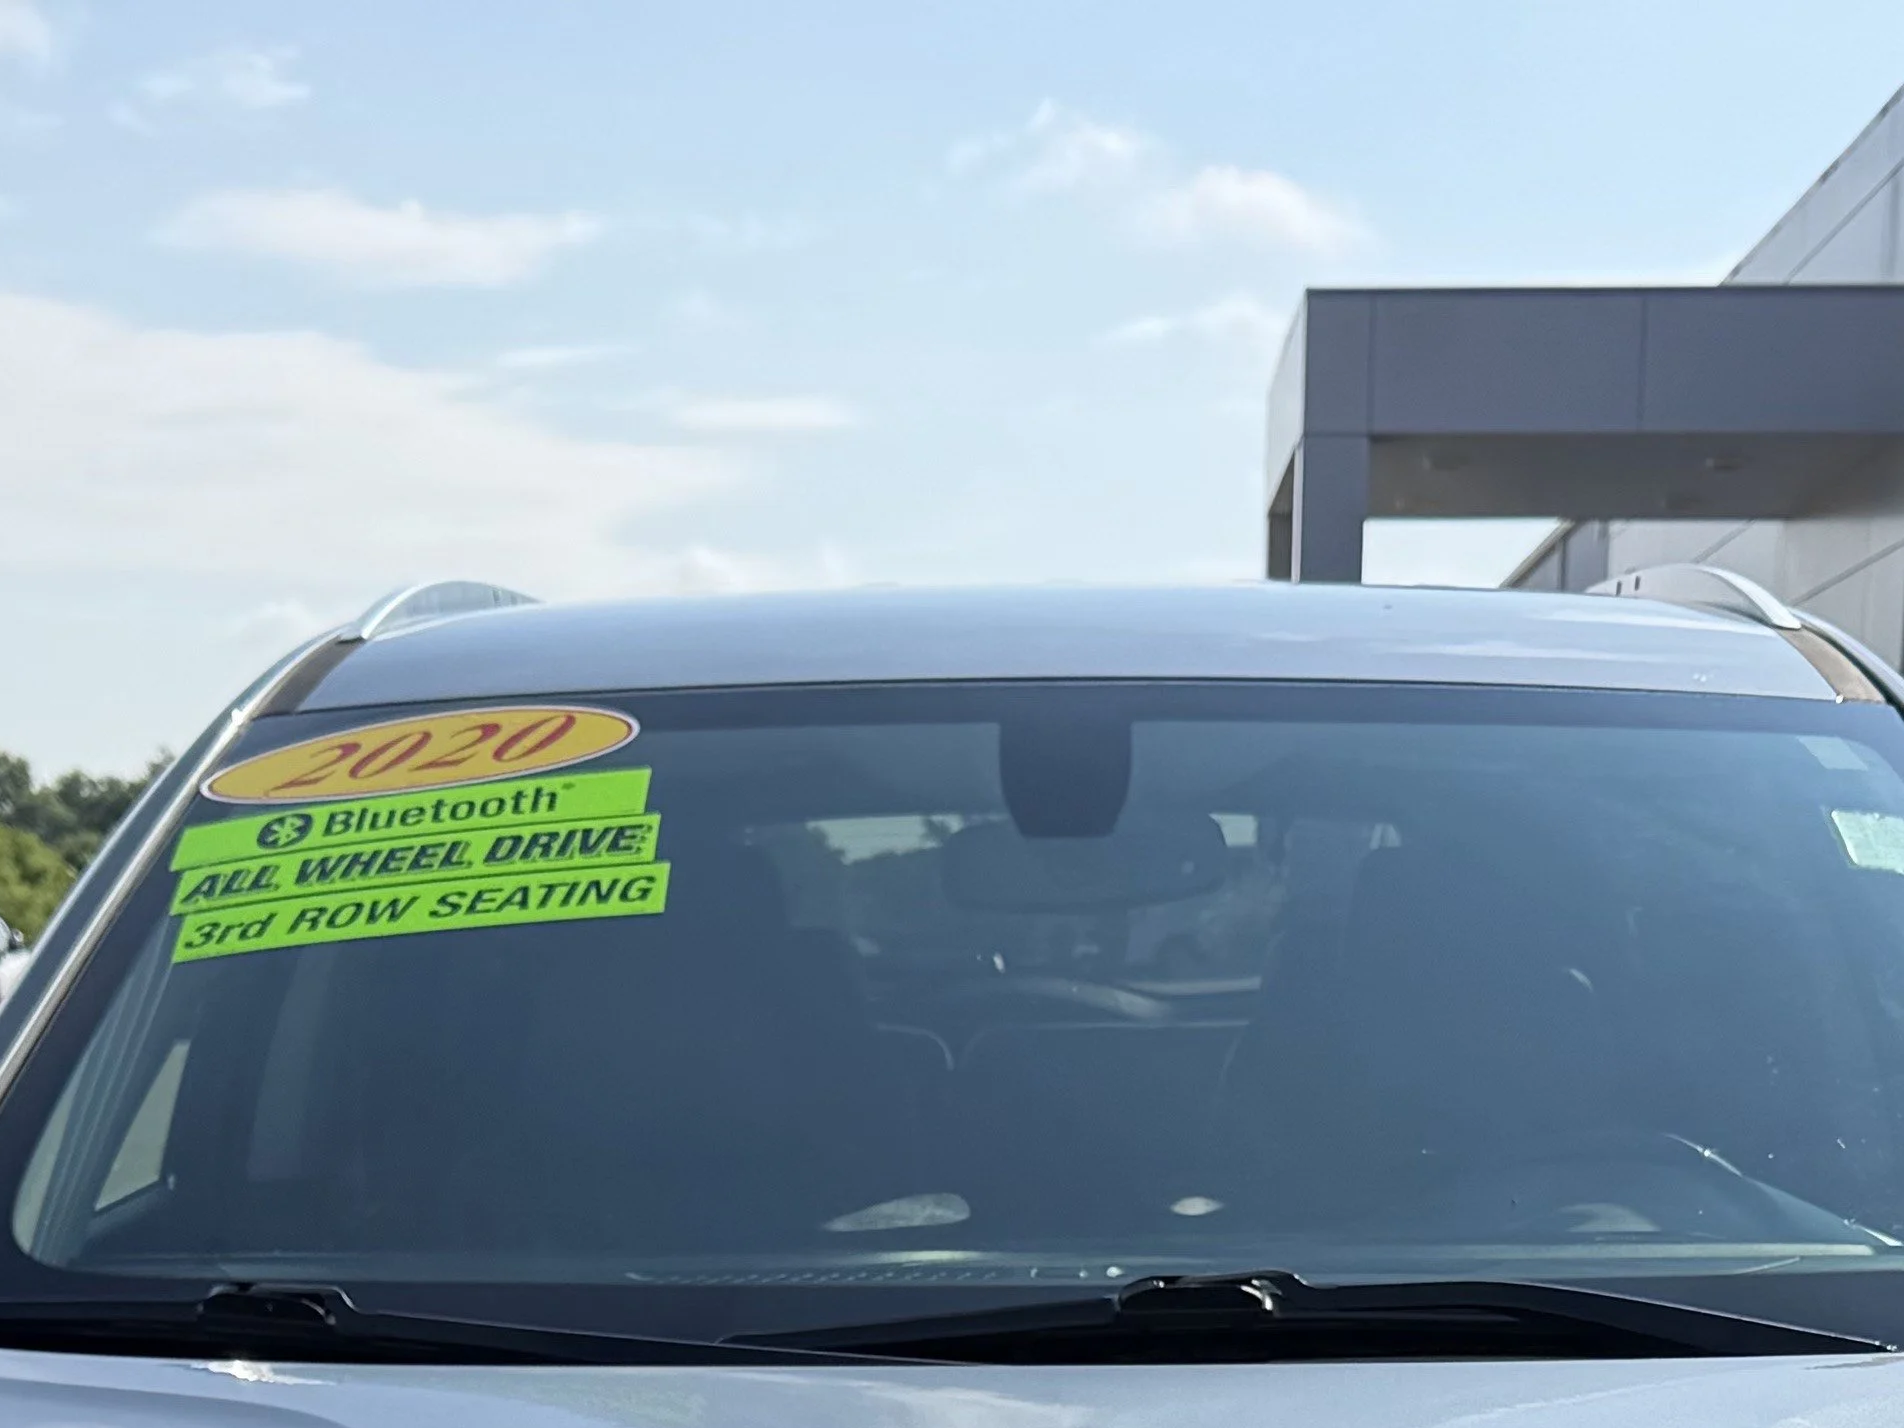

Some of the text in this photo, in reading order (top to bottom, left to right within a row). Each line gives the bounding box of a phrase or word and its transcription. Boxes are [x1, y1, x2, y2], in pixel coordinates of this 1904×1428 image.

[264, 714, 576, 797] 2020
[181, 824, 653, 904] ALL WHEEL DRIVE
[184, 876, 656, 949] 3rd ROW SEATING
